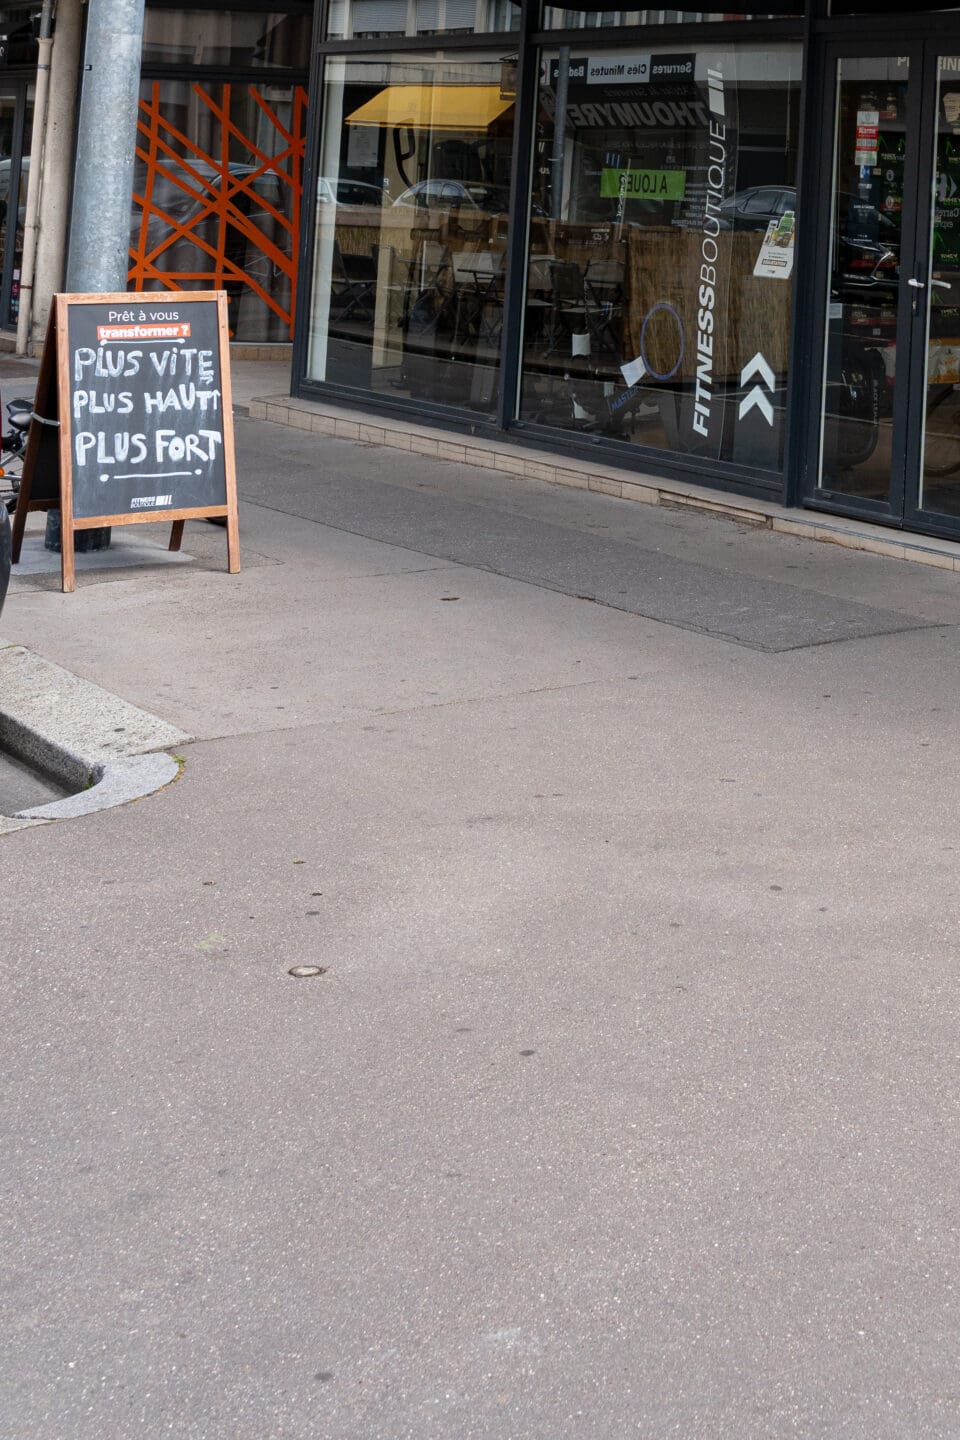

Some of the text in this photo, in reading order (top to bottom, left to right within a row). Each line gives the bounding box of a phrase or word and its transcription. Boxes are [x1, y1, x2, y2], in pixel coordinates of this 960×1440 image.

[100, 326, 178, 338] transformer
[108, 310, 179, 323] Prêt à vous
[74, 347, 143, 381] PLUS
[73, 382, 213, 418] PLUS HAUT
[75, 429, 221, 466] PLUS FORT
